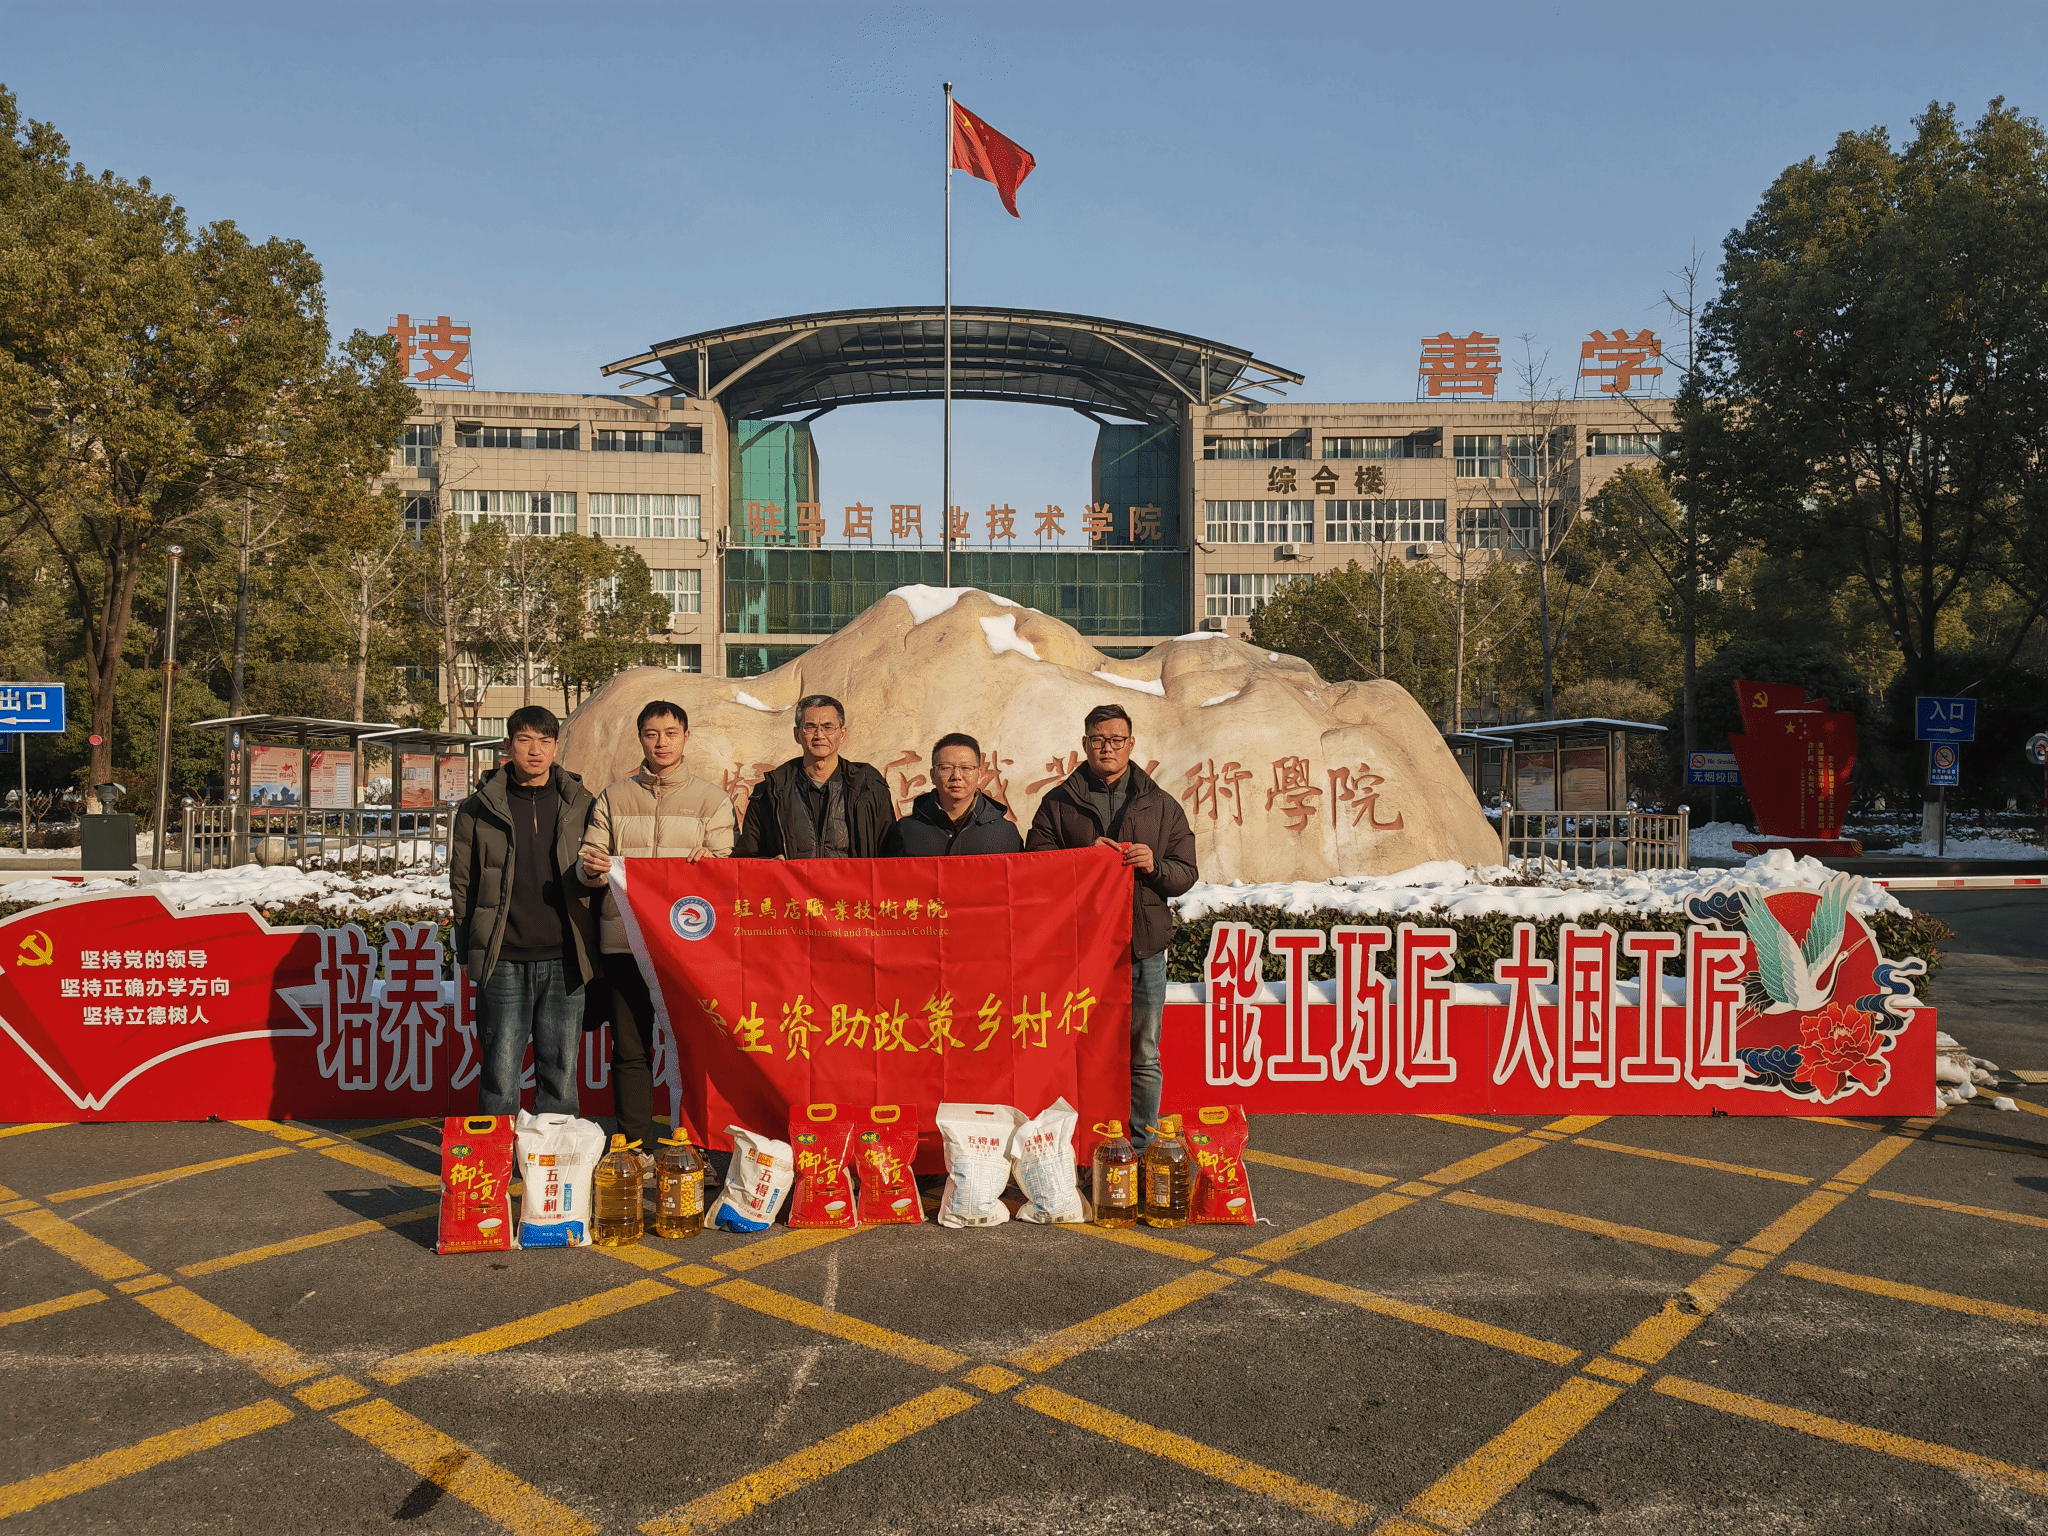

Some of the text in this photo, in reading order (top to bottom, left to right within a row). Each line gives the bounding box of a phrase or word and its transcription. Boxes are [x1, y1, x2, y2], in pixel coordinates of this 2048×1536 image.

[388, 314, 473, 383] 技
[1267, 465, 1385, 495] 综合楼
[745, 501, 1163, 542] 驻马店职业技术学院
[0, 689, 46, 711] 出口
[1930, 701, 1964, 720] 入口
[1693, 771, 1738, 783] 无烟校园
[734, 926, 949, 938] Zhumadian Vocational and Technical College
[81, 950, 207, 969] 坚持党的领导
[61, 977, 230, 998] 坚持正确办学方向
[83, 1005, 209, 1025] 坚持立德树人
[1206, 924, 1746, 1088] 能工巧匠 大国工匠
[544, 1169, 558, 1212] 五得利
[751, 1169, 773, 1211] 五得利
